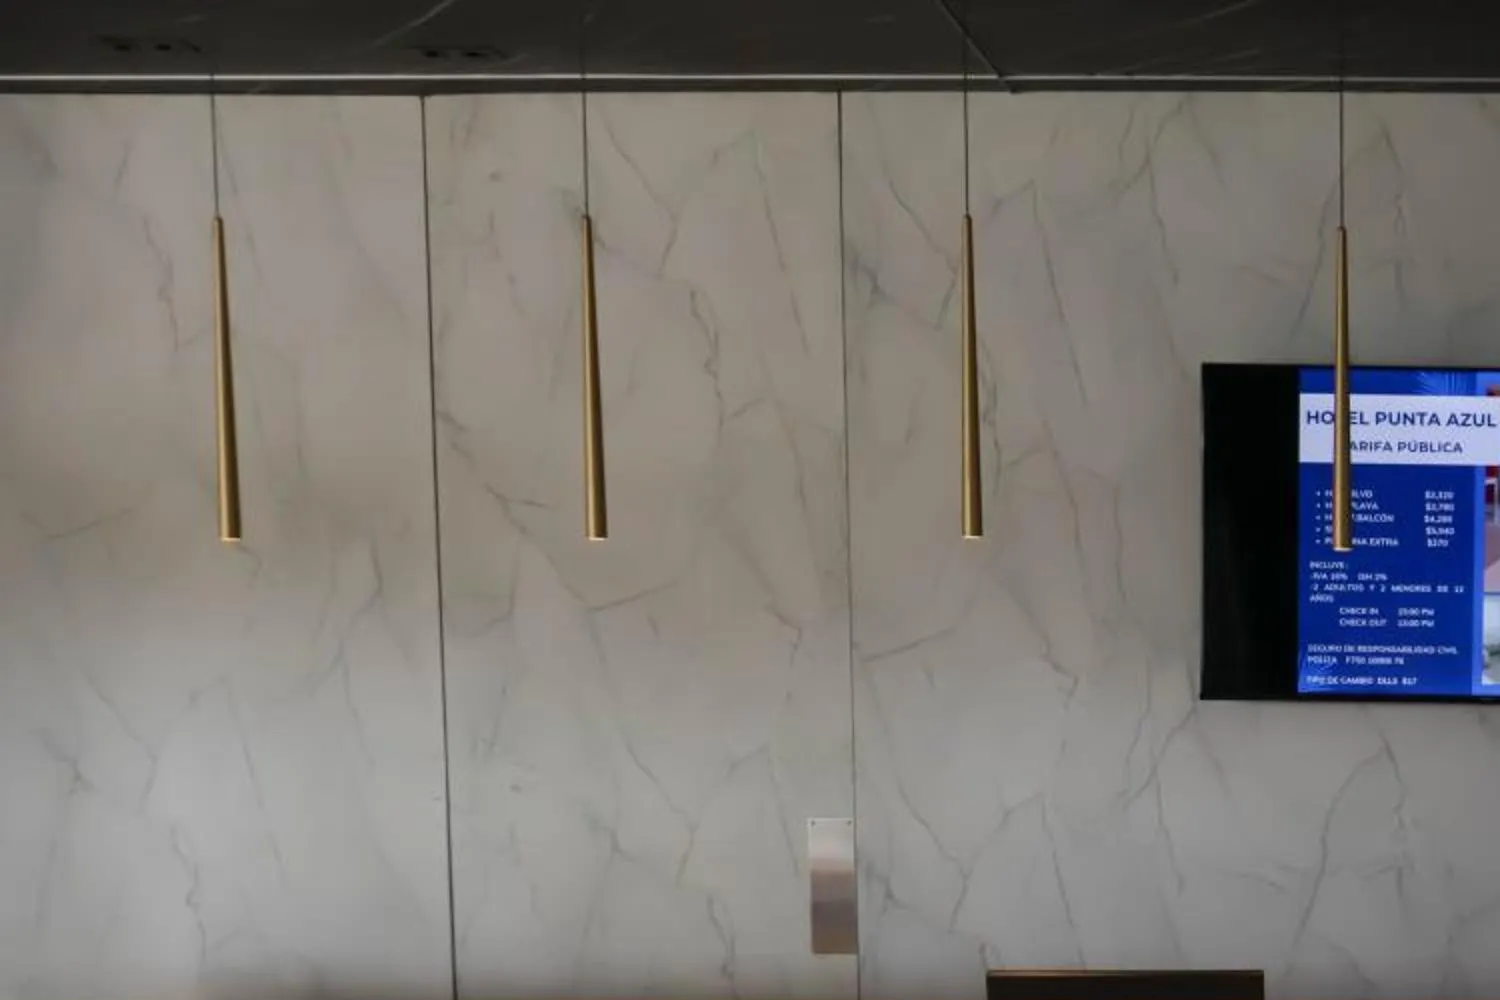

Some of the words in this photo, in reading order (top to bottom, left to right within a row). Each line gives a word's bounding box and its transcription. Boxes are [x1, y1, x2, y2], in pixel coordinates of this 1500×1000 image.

[1306, 410, 1369, 425] HOEL
[1375, 411, 1441, 427] PUNTA
[1446, 412, 1497, 427] AZUL
[1349, 440, 1393, 452] ARIFA
[1398, 439, 1463, 454] PÚBLICA
